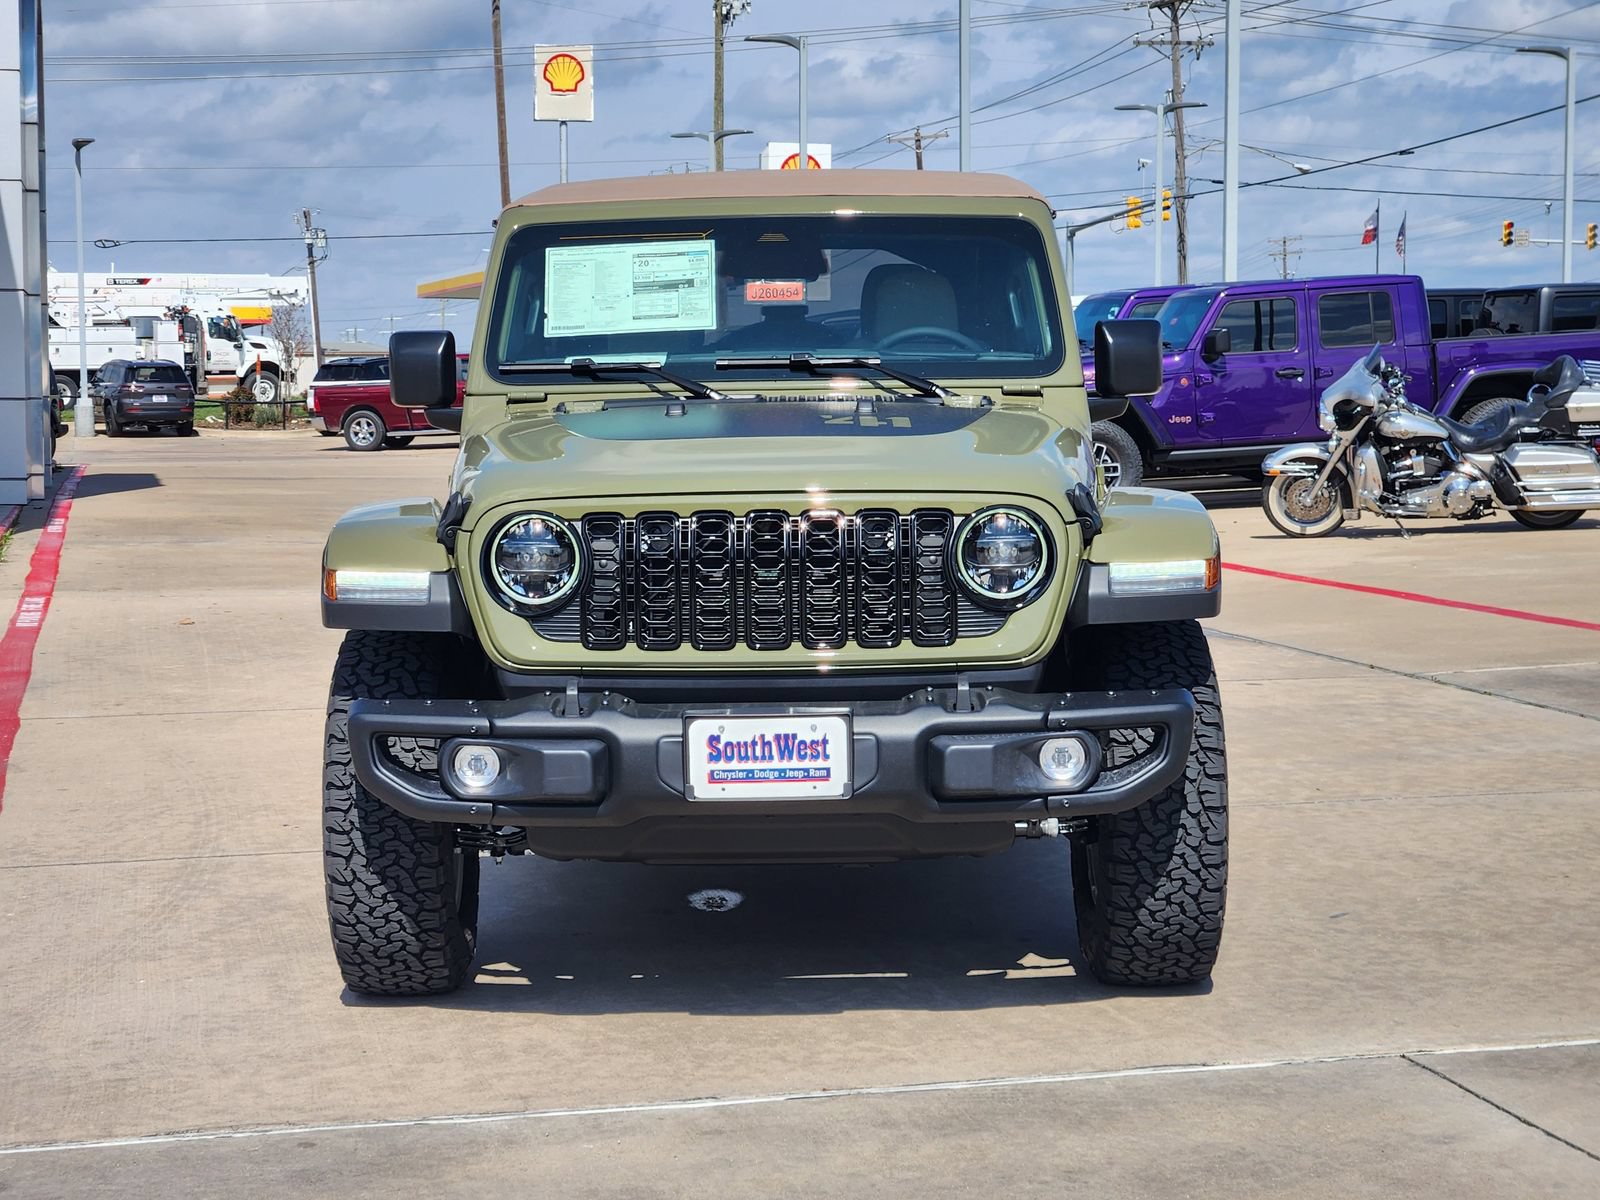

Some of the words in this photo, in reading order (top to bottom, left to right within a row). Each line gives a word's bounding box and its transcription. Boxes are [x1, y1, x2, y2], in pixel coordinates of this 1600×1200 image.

[638, 259, 650, 267] 20
[751, 287, 800, 299] J260454
[1168, 414, 1192, 424] Jeep
[706, 732, 830, 764] SouthWest
[713, 769, 747, 780] Chrysler
[754, 769, 779, 779] Dodge
[785, 768, 804, 779] Jeep
[809, 768, 827, 777] Ram
